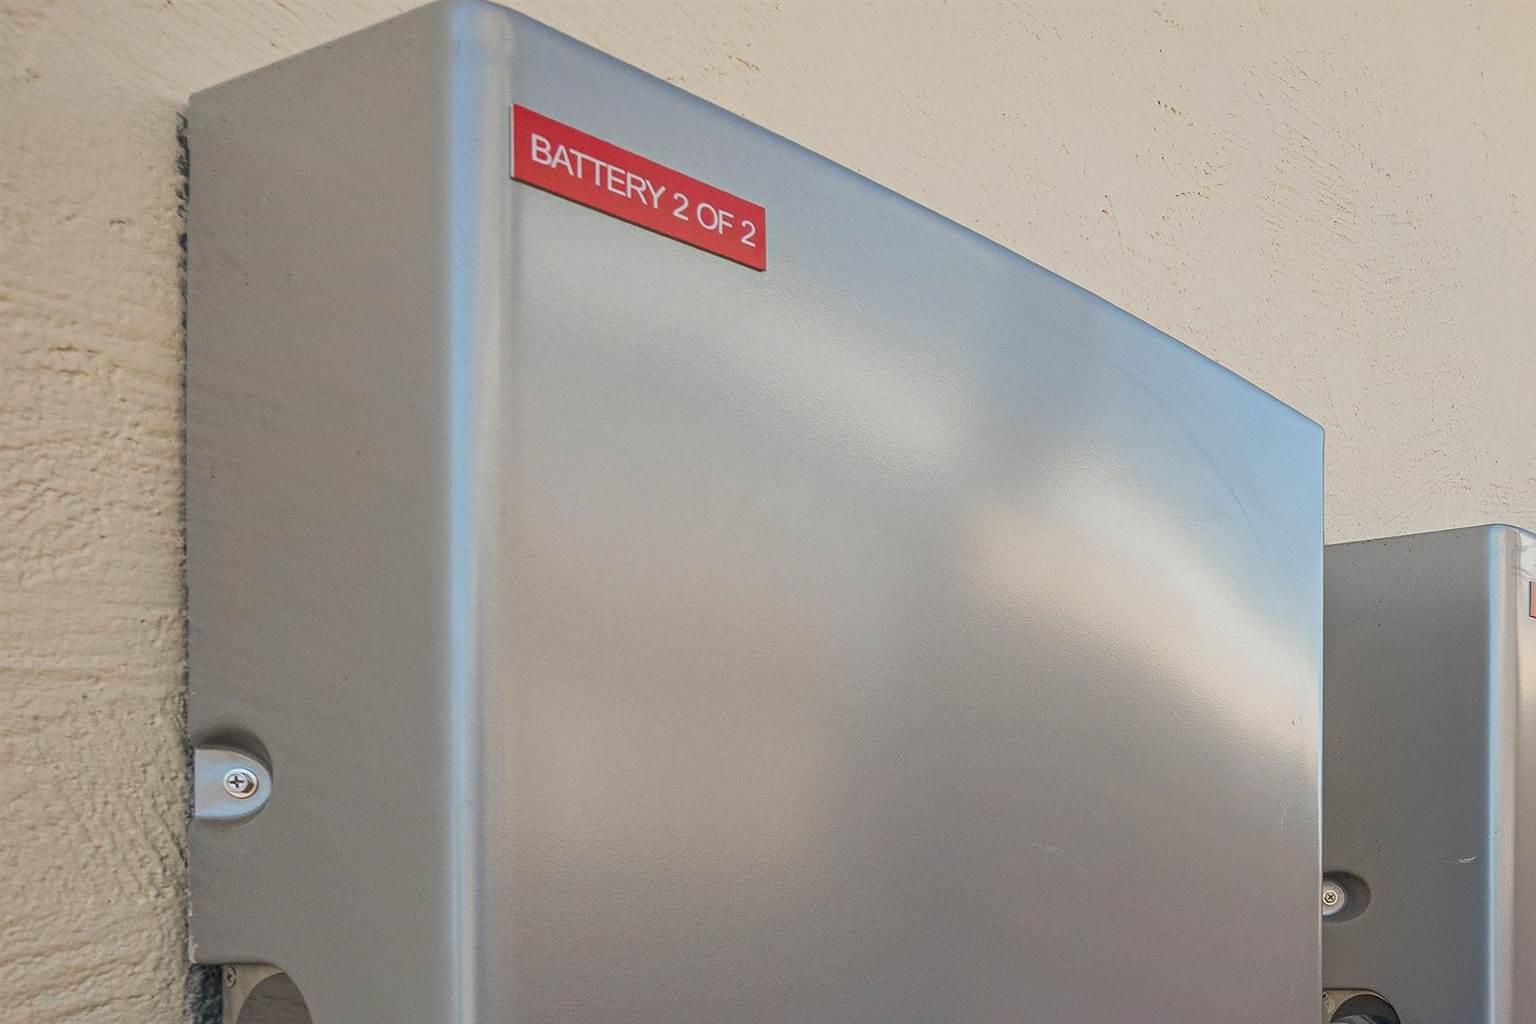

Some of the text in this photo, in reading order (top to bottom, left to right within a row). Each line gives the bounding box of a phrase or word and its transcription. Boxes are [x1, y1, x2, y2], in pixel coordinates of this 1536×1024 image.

[531, 133, 756, 247] BATTERY 2 OF 2
